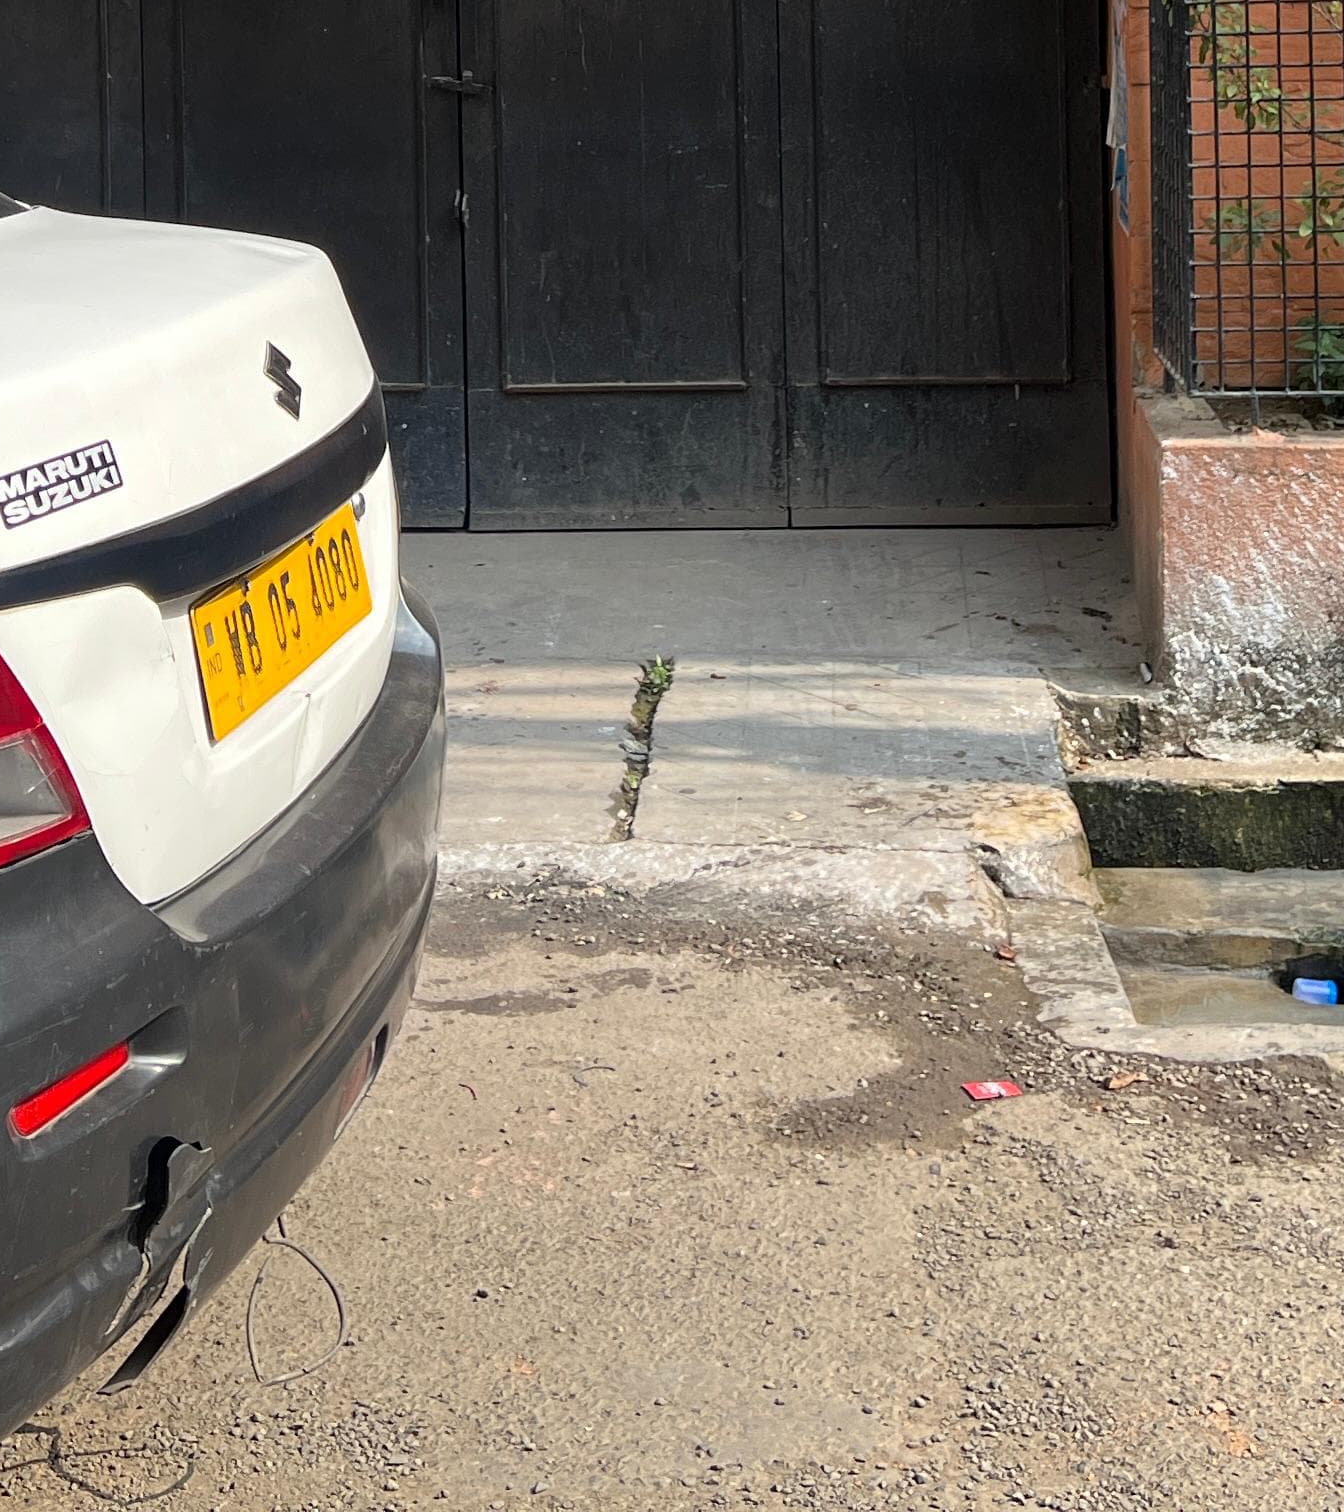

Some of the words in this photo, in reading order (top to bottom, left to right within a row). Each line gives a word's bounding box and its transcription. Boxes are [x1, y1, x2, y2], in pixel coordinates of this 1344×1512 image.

[3, 465, 121, 524] SUZUKI
[225, 600, 263, 675] WB
[267, 570, 301, 653] 05
[308, 527, 359, 617] 4080
